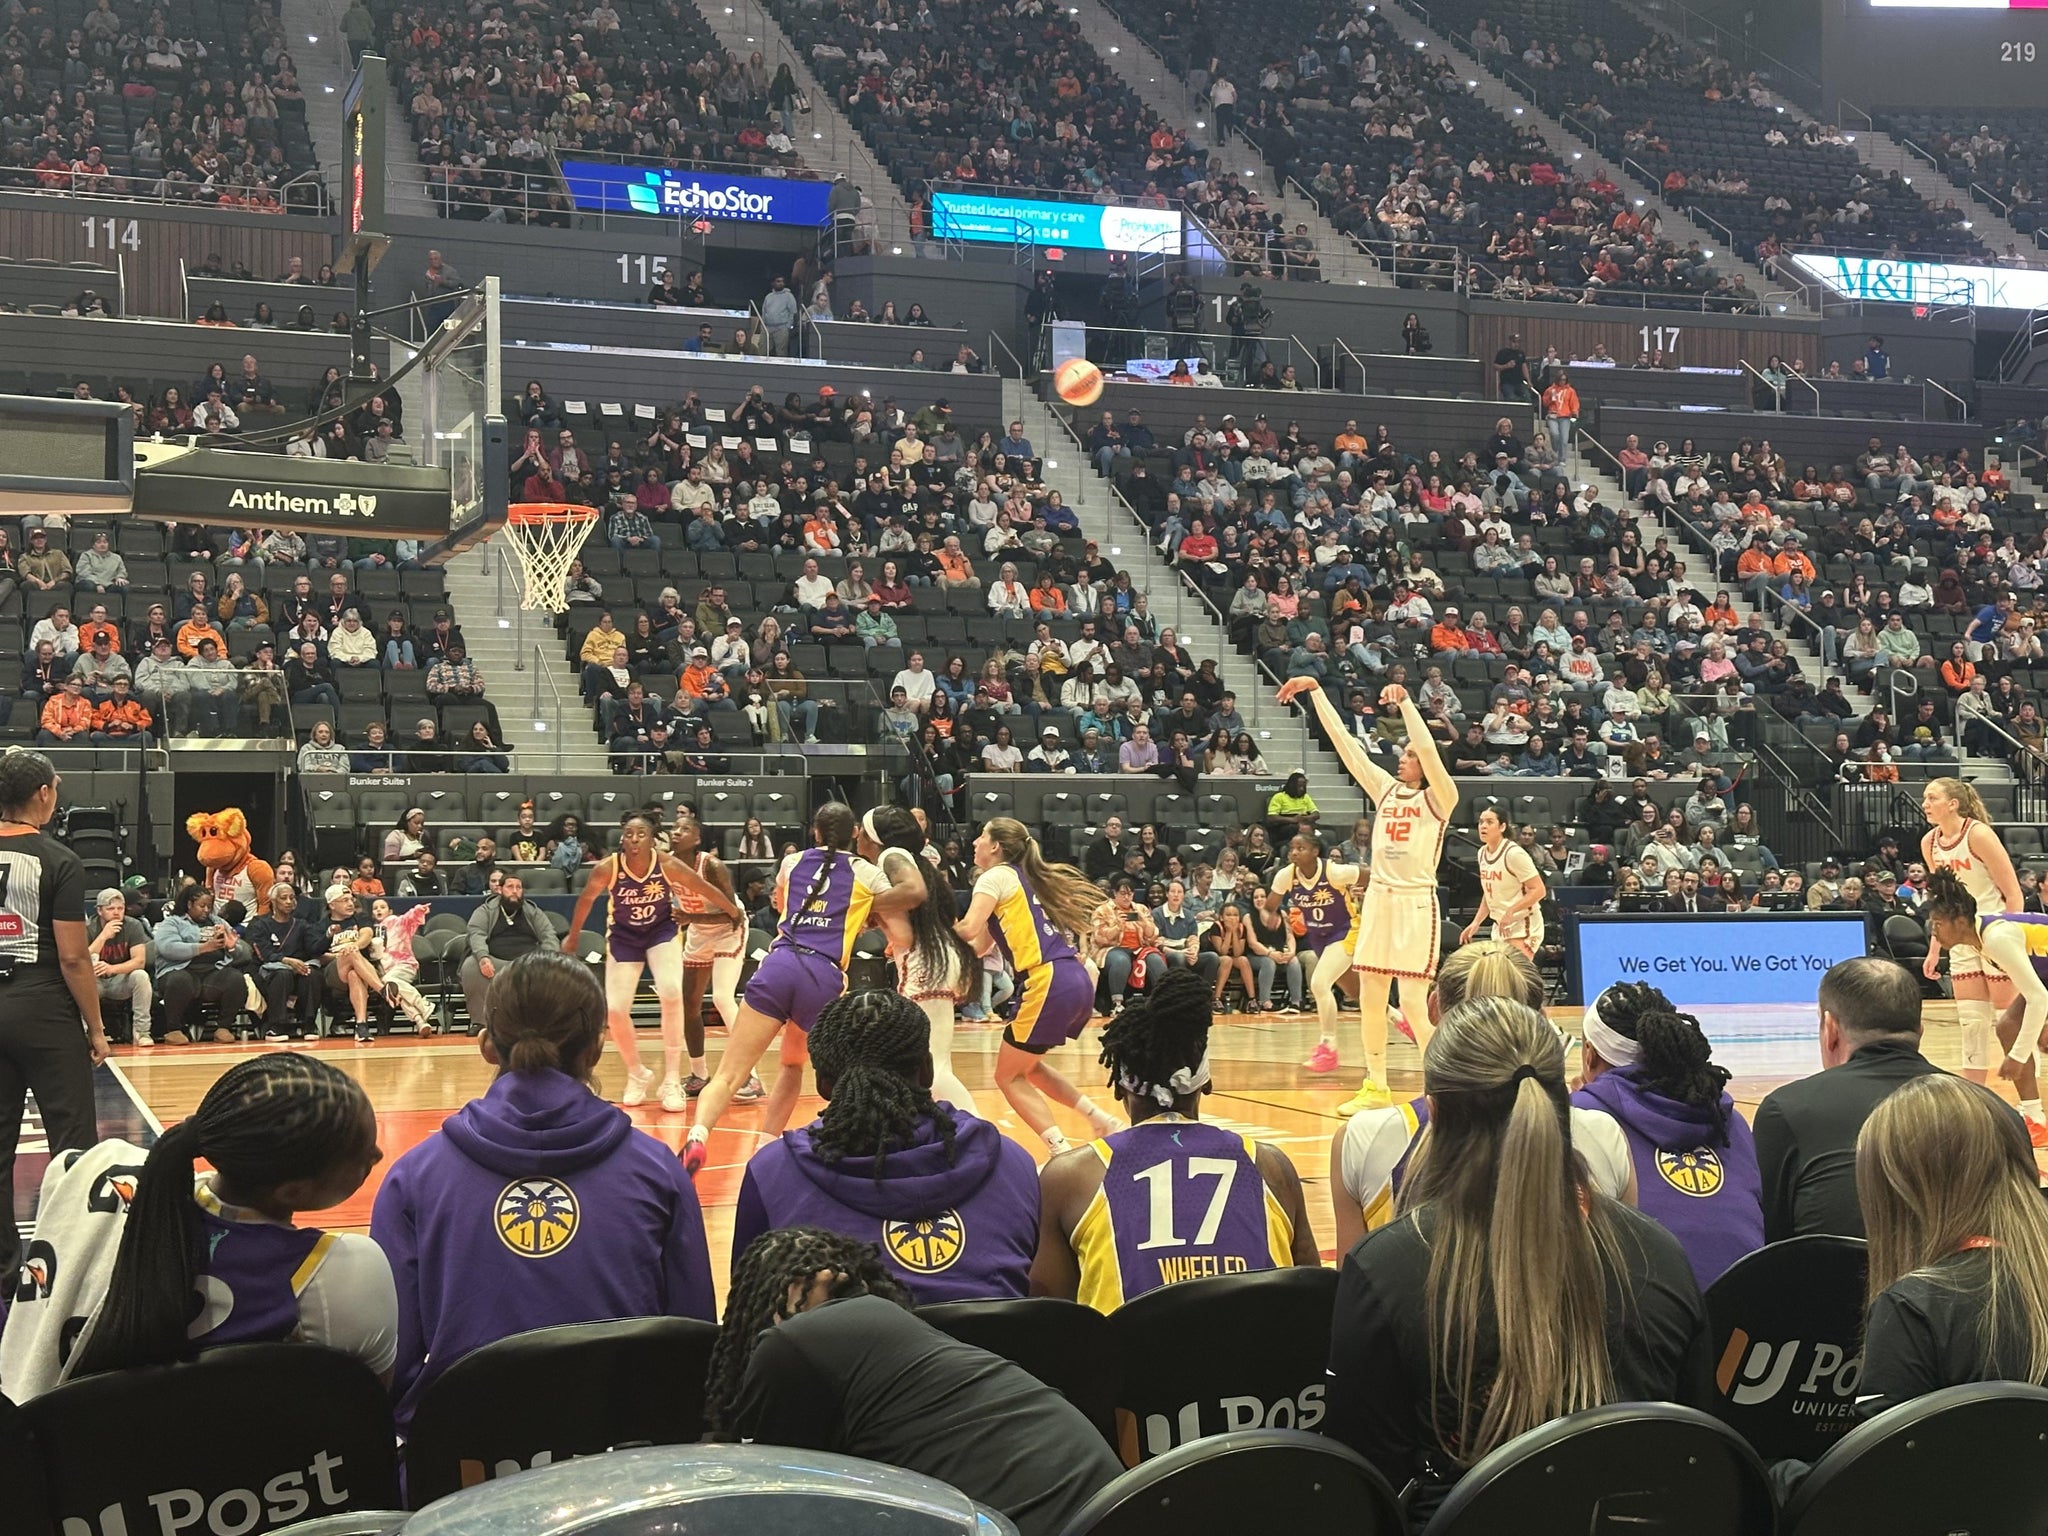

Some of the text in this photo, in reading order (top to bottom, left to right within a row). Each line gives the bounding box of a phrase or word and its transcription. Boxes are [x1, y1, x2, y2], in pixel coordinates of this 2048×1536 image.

[2000, 42, 2036, 62] 219
[664, 180, 773, 214] EchoStor
[943, 201, 1085, 224] Trusted local primary care
[82, 216, 141, 251] 114
[616, 254, 668, 286] 115
[1837, 256, 2009, 306] M&T Bank
[1639, 325, 1680, 353] 117
[349, 777, 411, 786] Bunker Suite 1
[696, 779, 725, 787] Bunker
[747, 779, 754, 787] 2
[1381, 806, 1421, 819] SUN
[1385, 821, 1411, 842] 42
[215, 875, 242, 888] SUN
[1480, 870, 1503, 882] SUN
[630, 904, 656, 921] 30
[802, 916, 832, 928] AT&T
[1312, 907, 1325, 921] 0
[1619, 957, 1649, 973] We
[1654, 956, 1687, 973] Get
[1690, 955, 1728, 973] You.
[1731, 955, 1762, 972] We
[1765, 955, 1798, 972] Got
[1133, 1156, 1238, 1250] 17
[1799, 1342, 1864, 1396] Po
[1219, 1383, 1327, 1433] Pos
[148, 1449, 350, 1536] Post
